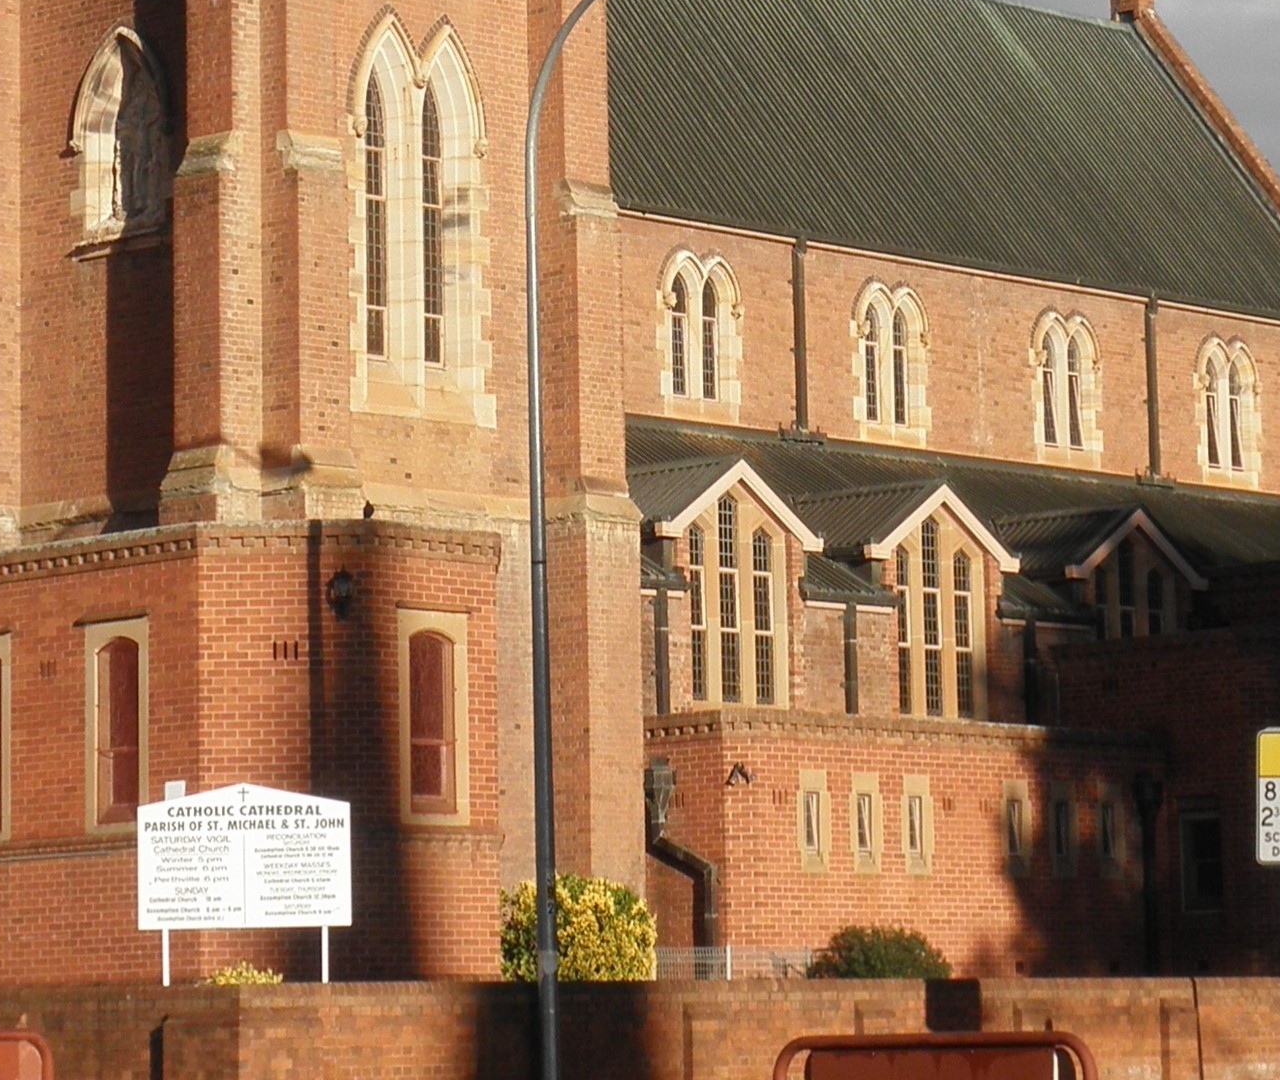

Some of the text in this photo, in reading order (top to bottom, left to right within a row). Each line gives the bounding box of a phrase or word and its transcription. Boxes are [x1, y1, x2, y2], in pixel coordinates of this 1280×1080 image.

[167, 804, 323, 818] CATHOLIC CATHEDRAL
[144, 818, 345, 832] PARISH OF ST. MICHAEL & ST. JOHN
[150, 835, 232, 844] SATURDAY VIGIL
[266, 833, 327, 841] RECONCILIATION
[153, 844, 230, 855] Cathedral Church
[206, 856, 223, 864] pm
[156, 865, 198, 873] Summer
[211, 865, 228, 873] pm
[213, 876, 230, 884] pm
[175, 887, 209, 895] SUNDAY
